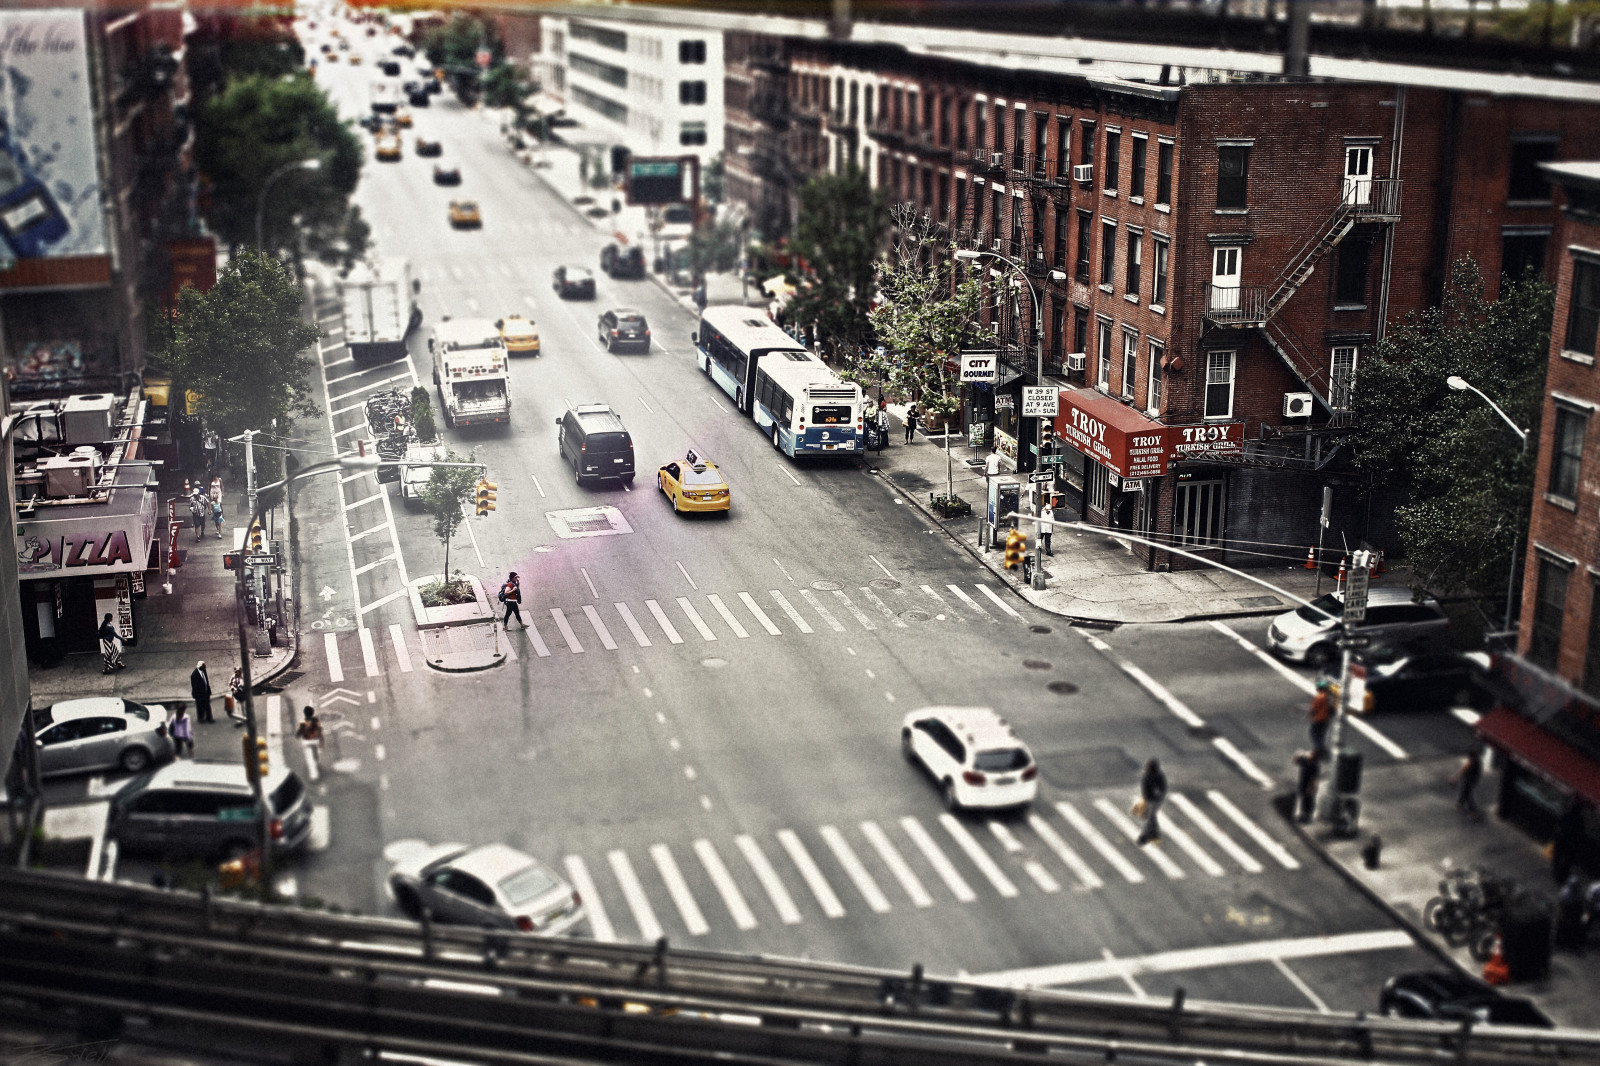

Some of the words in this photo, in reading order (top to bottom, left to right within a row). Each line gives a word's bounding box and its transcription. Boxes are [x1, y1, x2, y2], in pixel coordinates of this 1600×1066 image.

[968, 359, 990, 367] CITY
[995, 396, 1013, 405] ATM
[1071, 407, 1106, 443] TROY
[1183, 426, 1231, 442] TROY
[1065, 423, 1091, 448] TURKISH
[1093, 440, 1112, 460] GRILL
[1132, 435, 1162, 447] TROY
[1175, 443, 1210, 452] TURKISH
[1124, 481, 1141, 489] ATM
[23, 529, 133, 570] PIZZA
[1345, 600, 1365, 609] CARS
